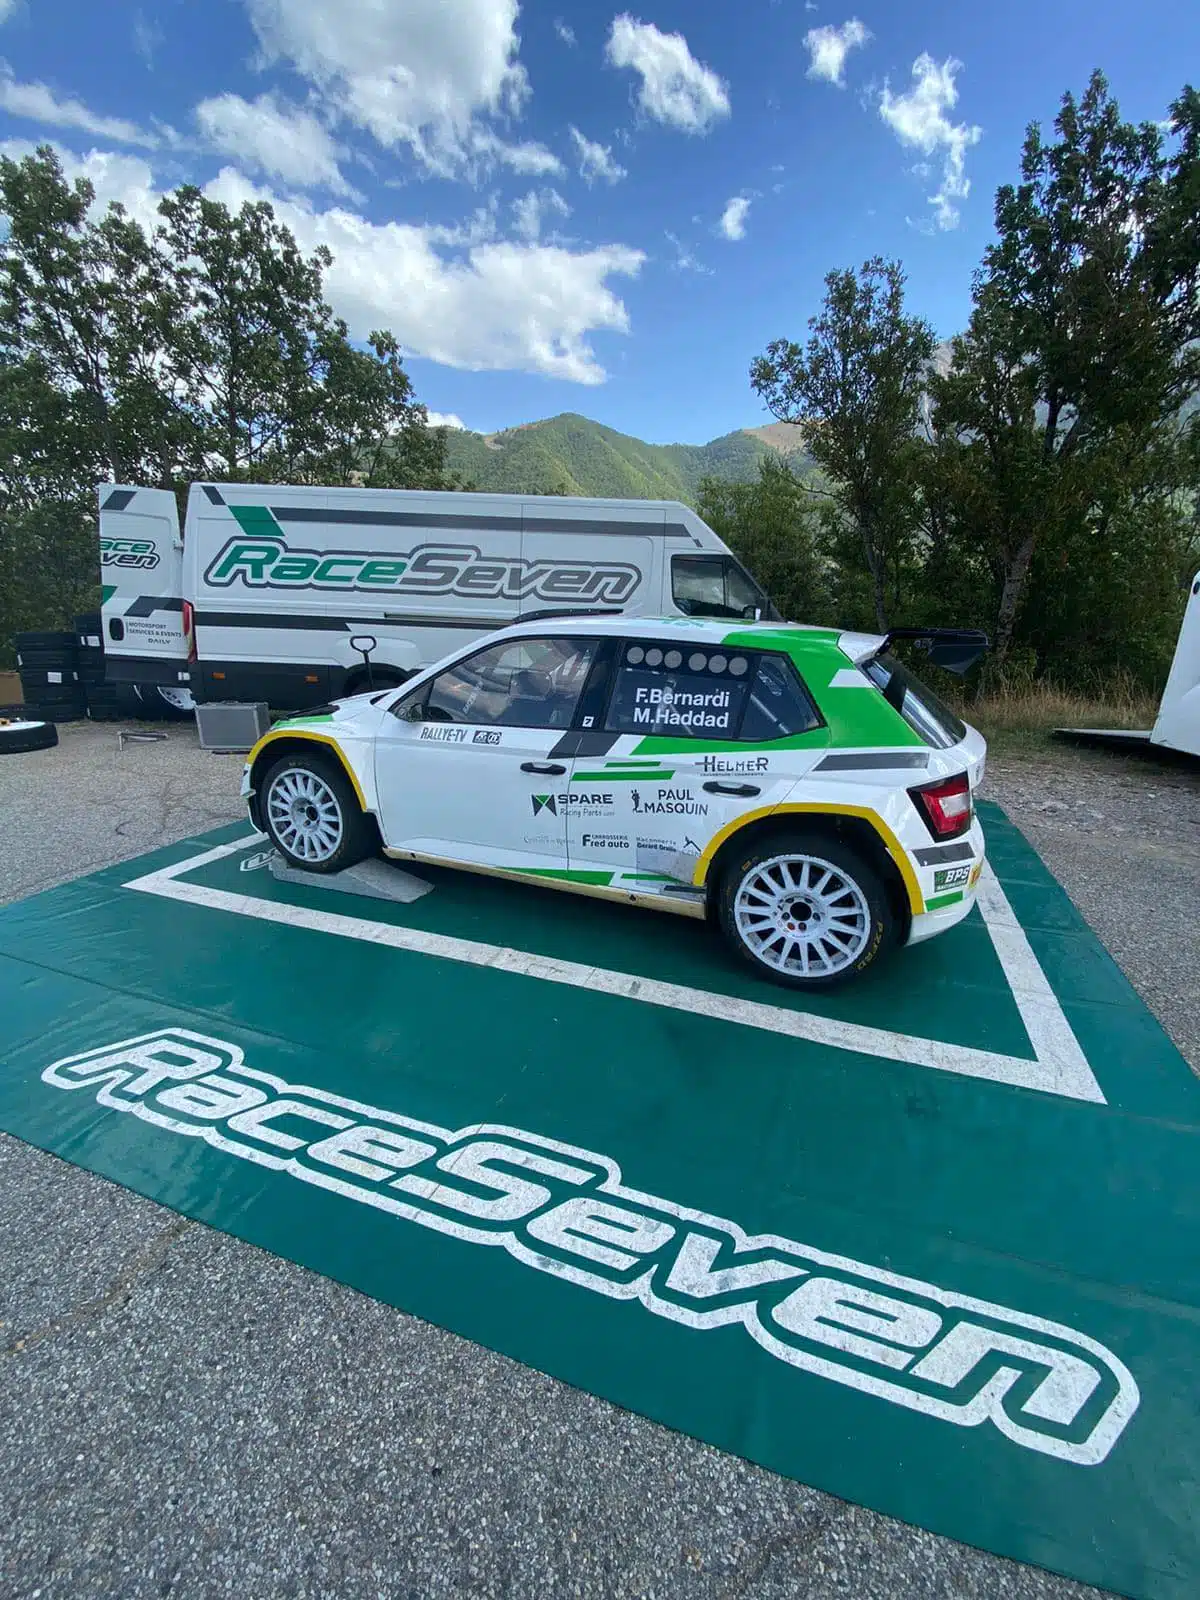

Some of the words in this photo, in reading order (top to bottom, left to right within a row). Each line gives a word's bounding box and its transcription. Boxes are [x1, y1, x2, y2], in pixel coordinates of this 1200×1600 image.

[100, 540, 152, 553] ace
[103, 552, 157, 567] ven
[212, 543, 630, 597] RaceSeven
[129, 622, 167, 630] MOTORSPORT
[129, 628, 154, 636] SERVICES
[635, 687, 731, 708] F.Bernardi
[633, 707, 730, 729] M.Haddad
[420, 726, 468, 742] RALLYE-TV
[557, 794, 614, 805] SPARE
[658, 789, 695, 801] PAUL
[644, 802, 709, 816] MASQUIN
[607, 840, 630, 849] auto
[945, 866, 971, 884] BPS
[62, 1034, 1110, 1435] RaceSeven
